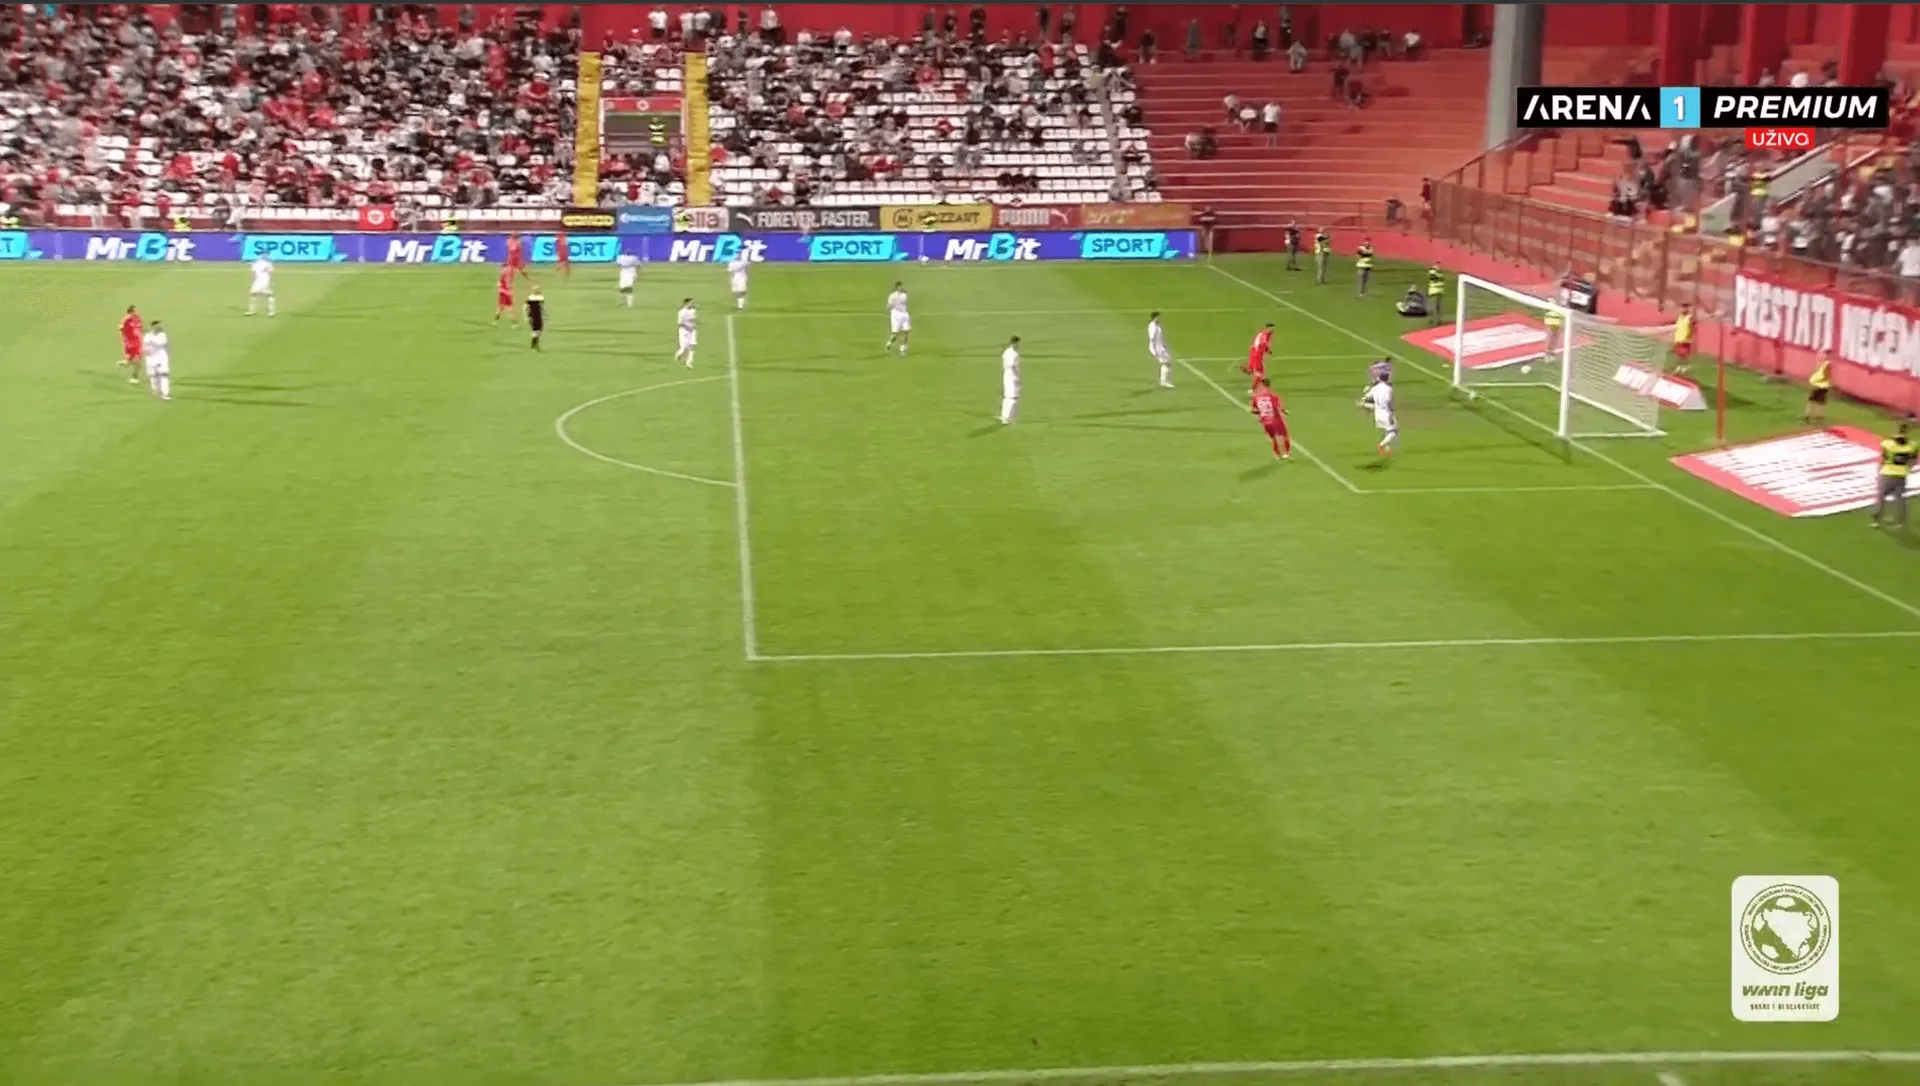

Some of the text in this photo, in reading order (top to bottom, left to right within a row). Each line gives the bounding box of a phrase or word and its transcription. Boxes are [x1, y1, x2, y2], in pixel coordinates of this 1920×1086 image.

[84, 232, 323, 262] MrBit SPORT
[385, 233, 608, 264] MrBit SORT
[669, 233, 884, 264] MrBit SPORT
[944, 232, 1157, 262] MrBit SPORT
